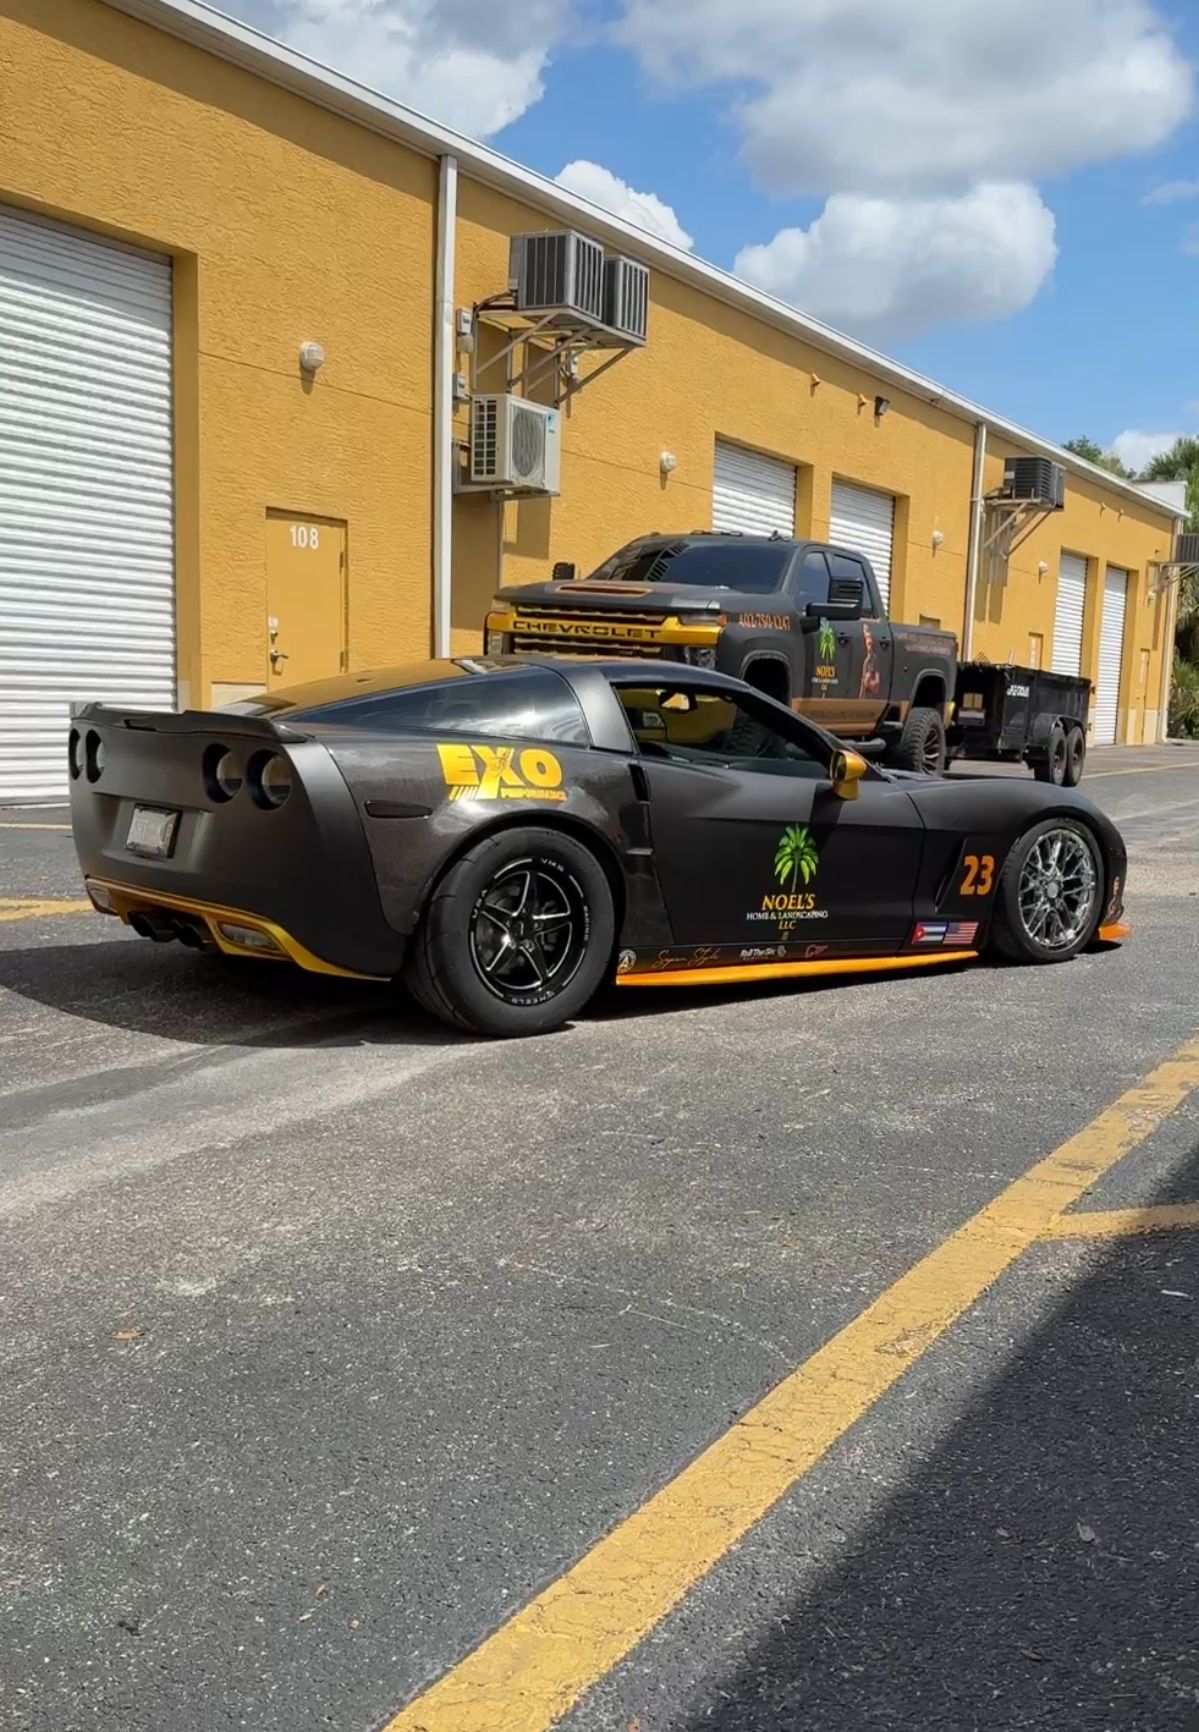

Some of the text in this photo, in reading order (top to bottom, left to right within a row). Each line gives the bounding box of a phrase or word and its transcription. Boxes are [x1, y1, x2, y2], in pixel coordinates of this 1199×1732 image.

[290, 525, 319, 550] 108
[513, 620, 661, 639] CHEVROLET
[436, 744, 563, 799] EXO
[960, 855, 995, 896] 23
[761, 893, 816, 911] NOEL'S
[746, 912, 769, 920] HOME
[778, 920, 797, 930] LLC
